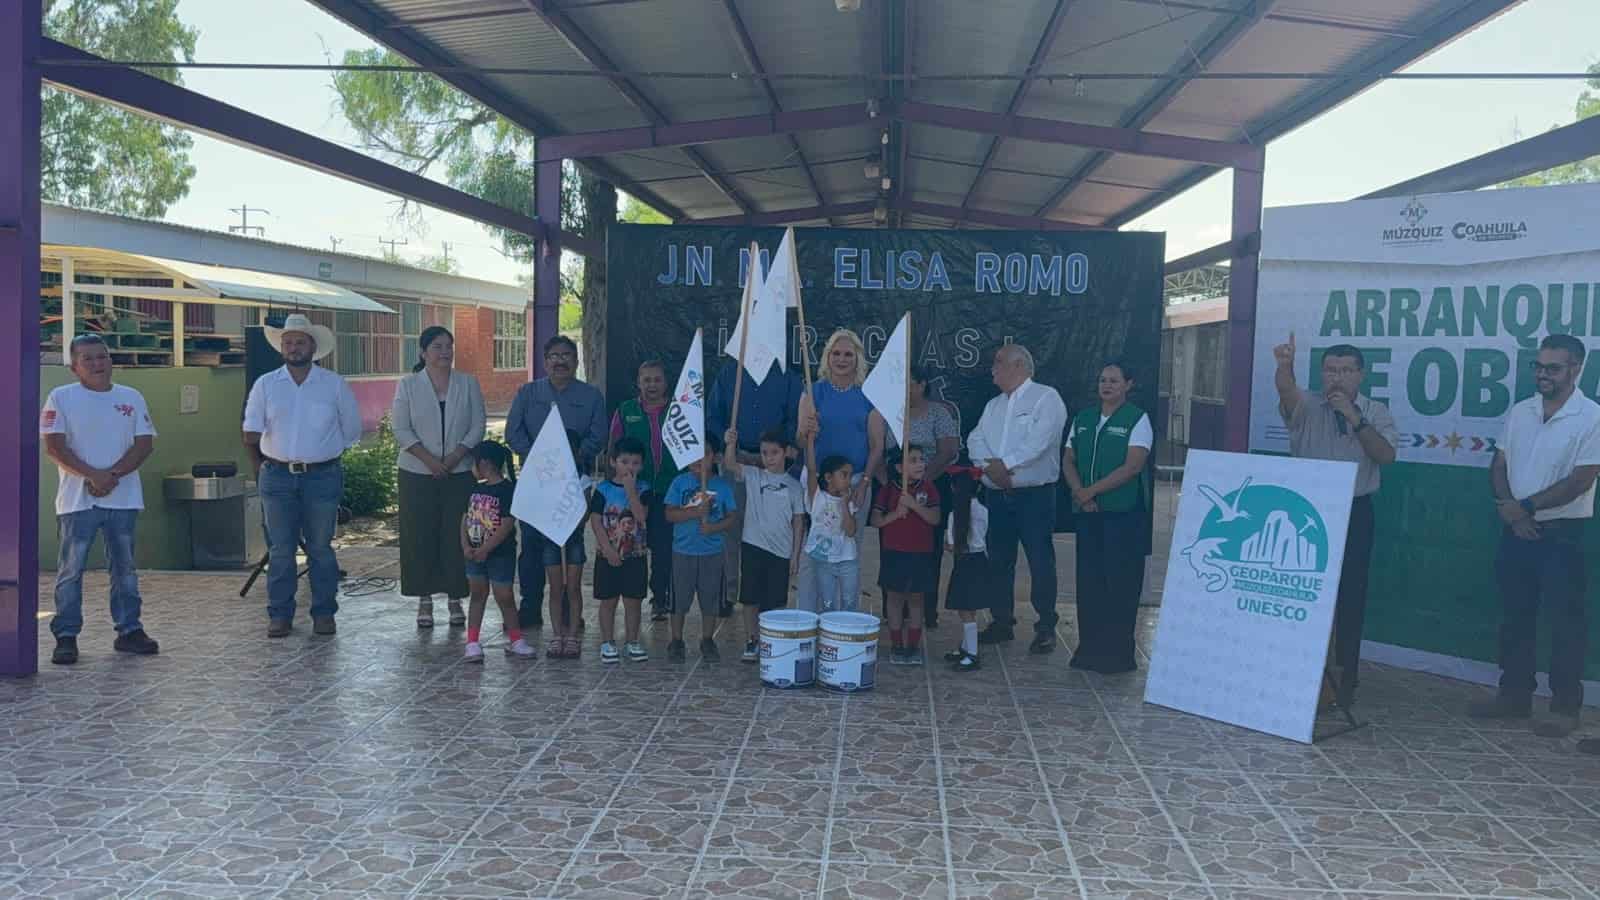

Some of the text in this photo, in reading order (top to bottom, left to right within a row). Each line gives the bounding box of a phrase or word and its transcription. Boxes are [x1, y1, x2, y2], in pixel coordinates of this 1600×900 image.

[1451, 221, 1528, 239] COAHUILA
[833, 247, 952, 292] ELISA
[975, 252, 1089, 296] ROMO
[1230, 565, 1323, 591] GEOPARQUE
[1236, 596, 1307, 622] UNESCO
